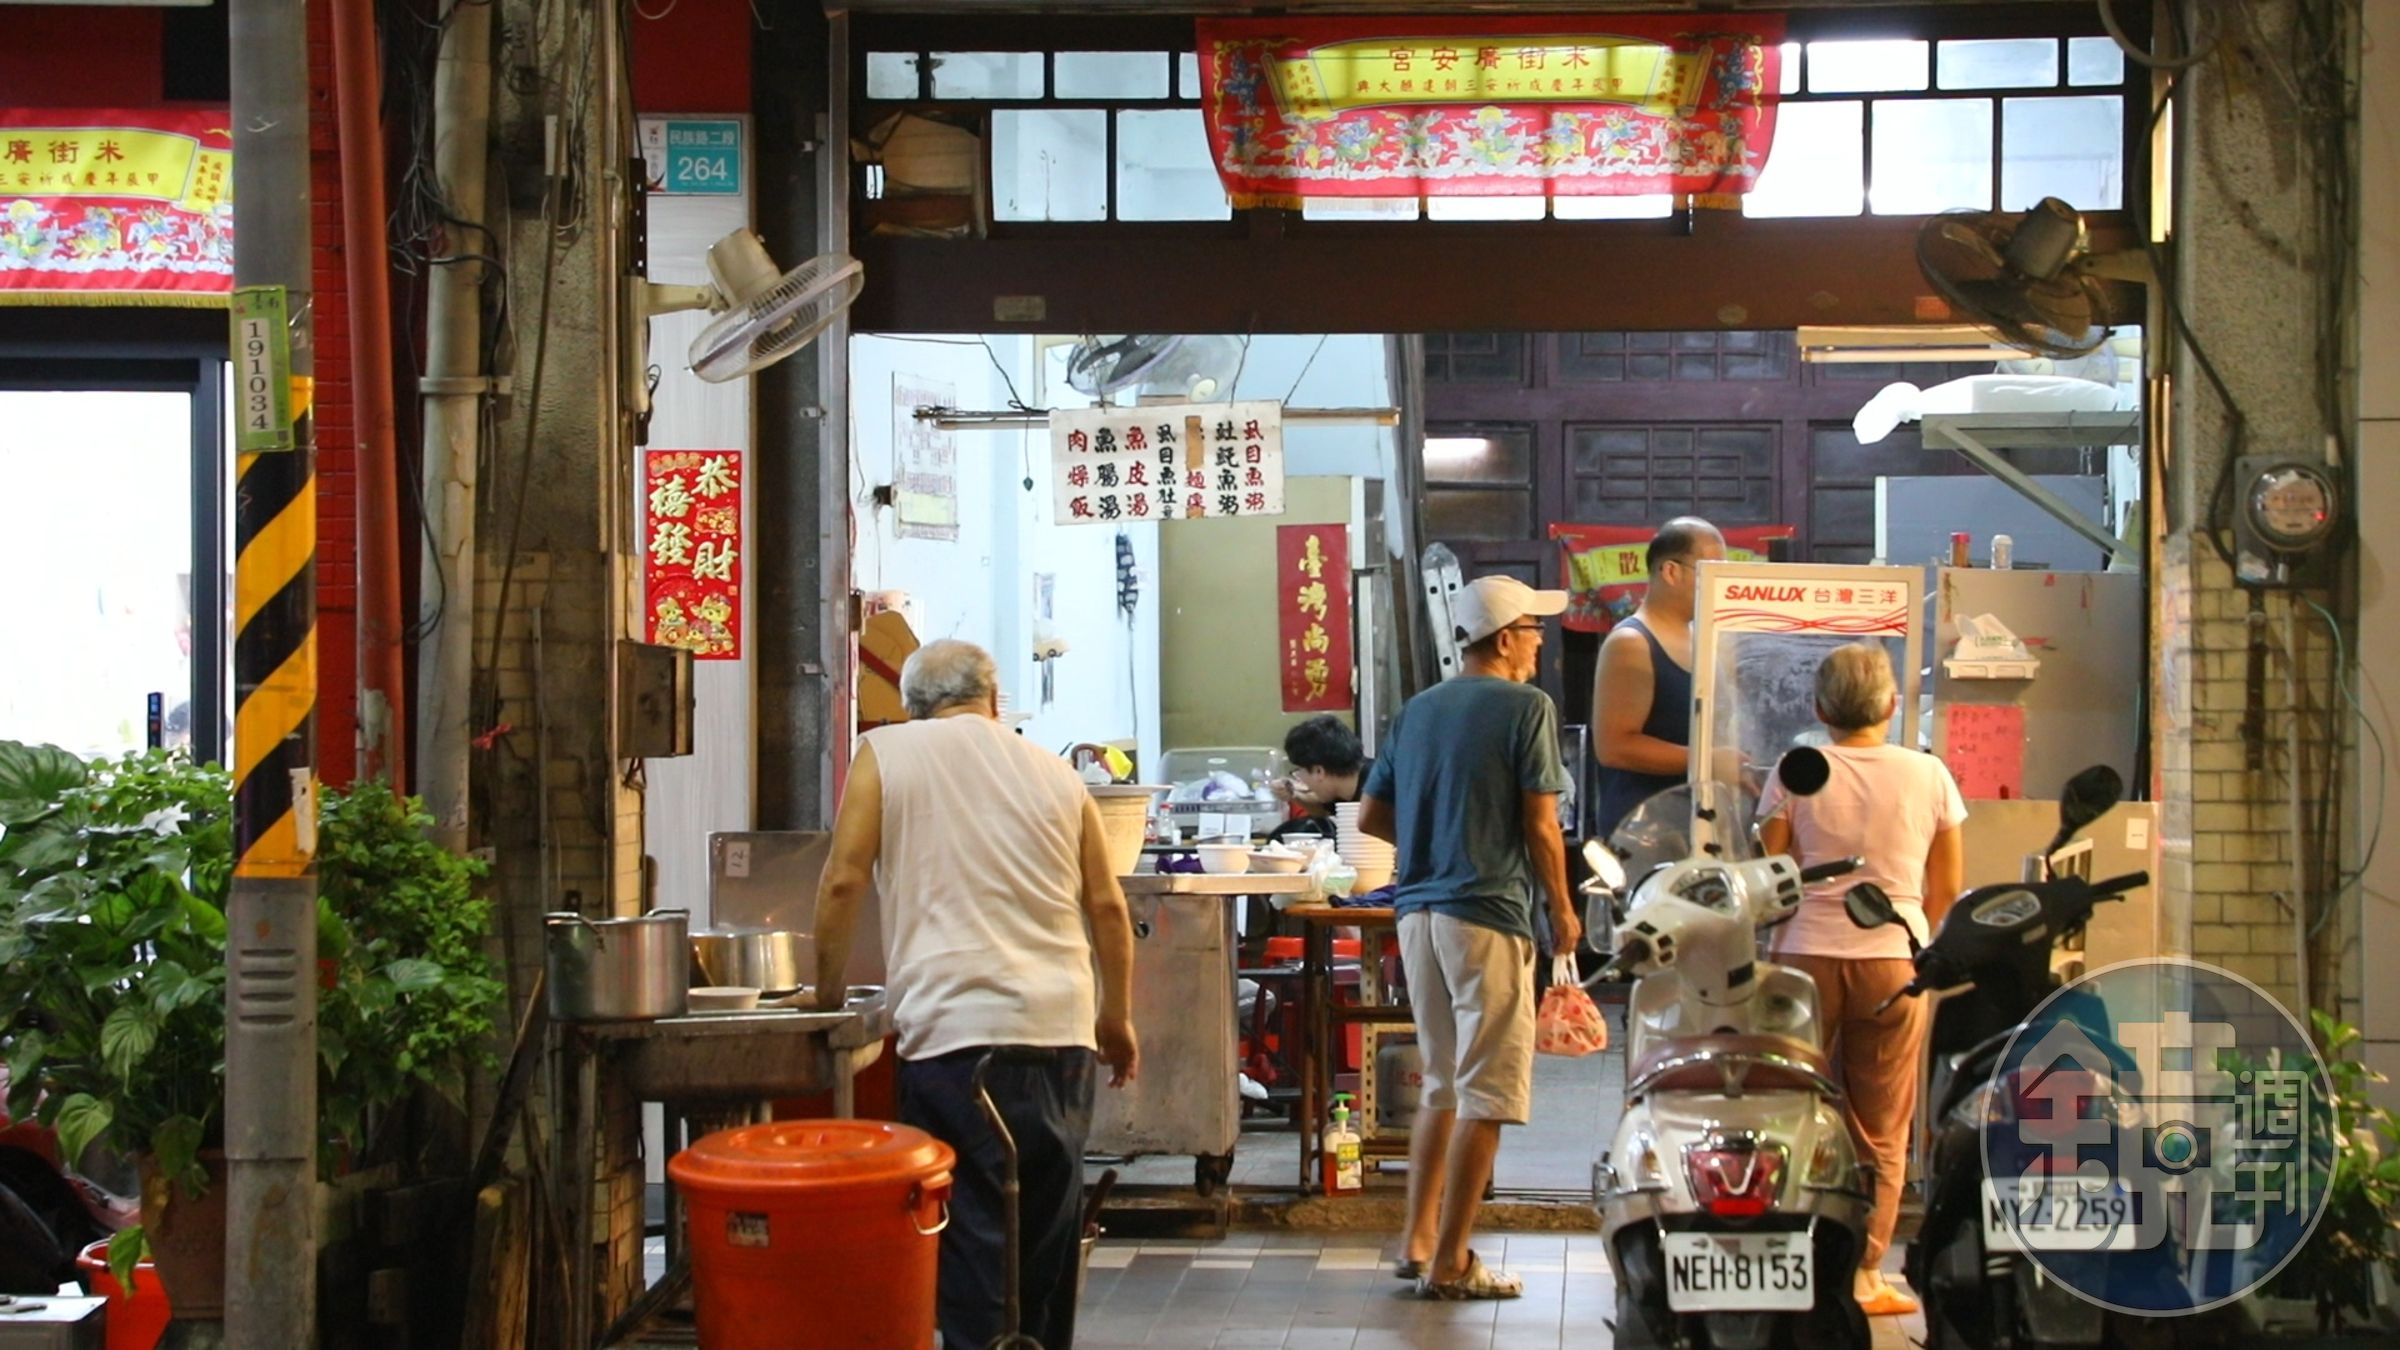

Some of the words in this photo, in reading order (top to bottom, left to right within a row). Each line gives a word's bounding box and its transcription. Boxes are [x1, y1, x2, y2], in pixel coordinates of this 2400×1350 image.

[669, 131, 736, 146] 民族路二段
[677, 156, 728, 181] 264
[247, 321, 268, 431] 191034
[1124, 425, 1149, 517] 魚皮湯
[1724, 584, 1808, 603] SANLUX
[1814, 587, 1898, 605] 台灣三洋
